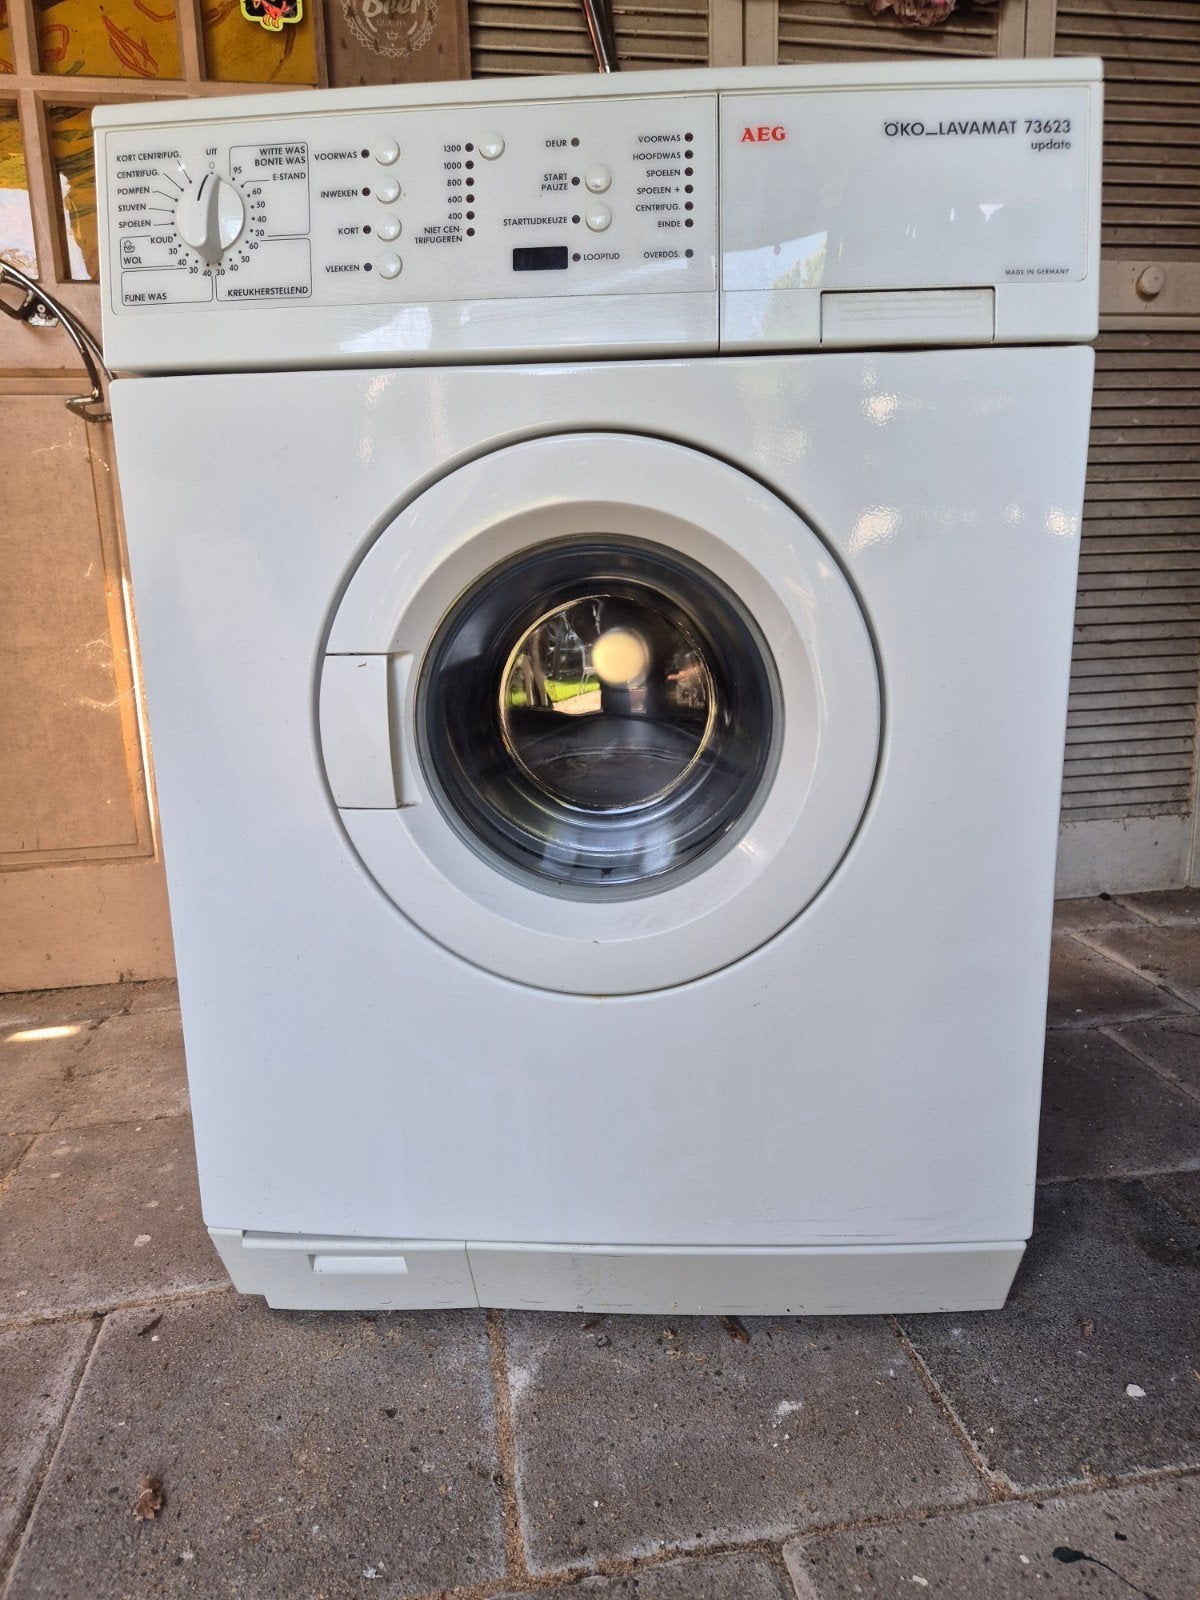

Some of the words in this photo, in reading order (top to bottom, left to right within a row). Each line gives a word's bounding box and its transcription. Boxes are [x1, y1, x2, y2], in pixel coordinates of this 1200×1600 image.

[1024, 119, 1072, 134] 73623
[637, 134, 681, 143] VOORWAS
[740, 126, 787, 143] AEG
[545, 139, 567, 148] DEUR
[1030, 138, 1072, 153] update
[206, 147, 218, 156] UIT
[259, 146, 284, 156] WITTE
[285, 145, 306, 155] WAS
[443, 144, 462, 153] 1300
[116, 152, 136, 163] KORT
[138, 150, 182, 162] CENTRIFUG.
[314, 151, 358, 161] VOORWAS
[632, 151, 681, 161] HOOFDWAS
[254, 157, 283, 167] BONTE
[285, 155, 306, 166] WAS
[233, 166, 243, 175] 95
[443, 162, 462, 170] 1000
[117, 168, 161, 179] CENTRIFUG.
[272, 172, 306, 181] E-STAND
[544, 173, 568, 182] START
[646, 168, 681, 178] SPOELEN
[447, 179, 462, 187] 800
[541, 183, 569, 192] PAUZE
[117, 186, 151, 196] POMPEN
[252, 187, 262, 196] 60
[320, 188, 358, 199] INWEKEN
[636, 186, 672, 195] SPOELEN
[447, 195, 462, 204] 600
[256, 201, 266, 209] 50
[635, 202, 681, 212] CENTRIFUG.
[257, 215, 267, 224] 40
[447, 212, 463, 220] 400
[118, 219, 152, 229] SPOELEN
[657, 220, 682, 228] EINDE
[255, 229, 265, 238] 30
[337, 226, 360, 236] KORT
[424, 226, 442, 235] NIET
[443, 225, 463, 234] CEN-
[150, 235, 174, 244] KOUD
[414, 235, 463, 244] TRIFUGEREN
[249, 242, 259, 250] 60
[168, 247, 178, 256] 30
[643, 250, 681, 260] OVERDOS.
[123, 256, 142, 266] WOL
[177, 258, 188, 267] 40
[241, 255, 251, 264] 50
[189, 266, 199, 275] 30
[229, 263, 240, 272] 40
[325, 263, 360, 273] VLEKKEN
[1005, 268, 1025, 276] MADE
[1036, 267, 1070, 275] GERMANY
[202, 269, 212, 277] 40
[216, 268, 226, 277] 30
[149, 291, 168, 301] WAS
[227, 285, 309, 298] KREUKHERSTELLEND
